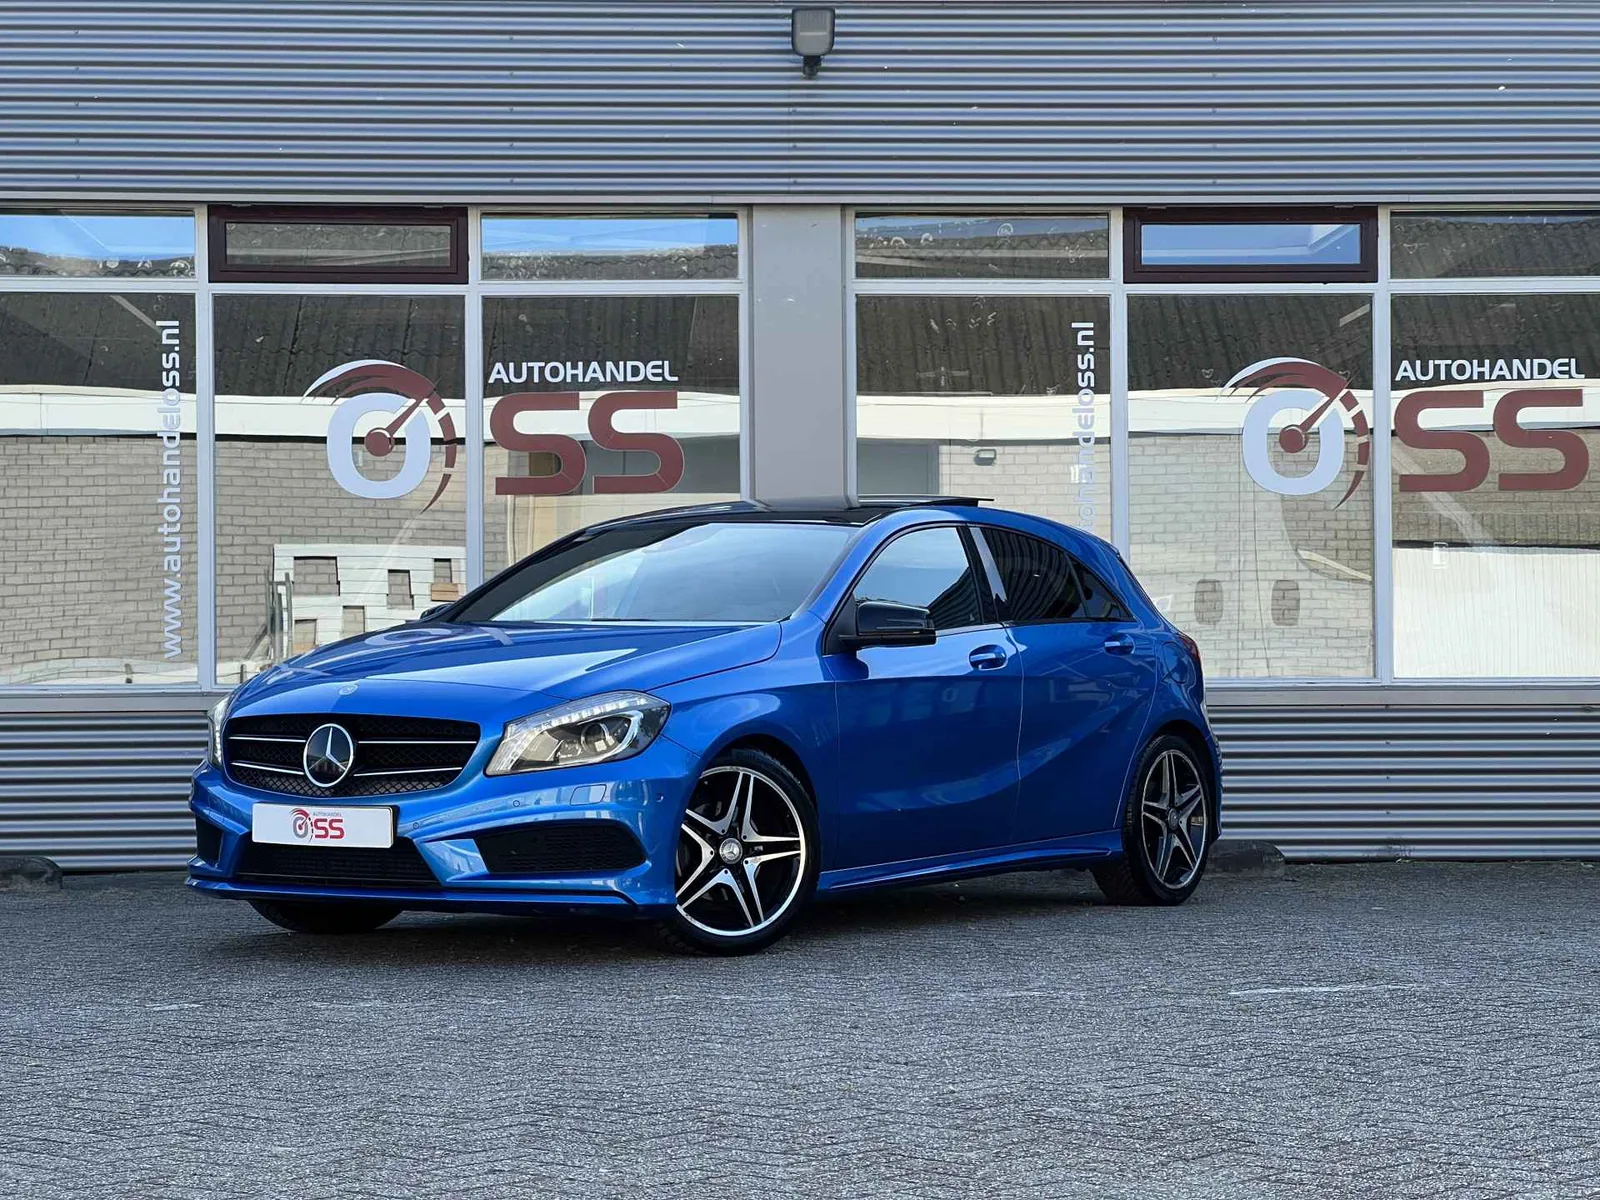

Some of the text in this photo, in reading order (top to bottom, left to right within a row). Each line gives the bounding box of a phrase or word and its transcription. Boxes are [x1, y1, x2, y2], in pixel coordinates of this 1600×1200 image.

[488, 360, 679, 384] AUTOHANDEL
[1395, 358, 1585, 381] AUTOHANDEL
[156, 320, 181, 659] www.autohandeloss.nl
